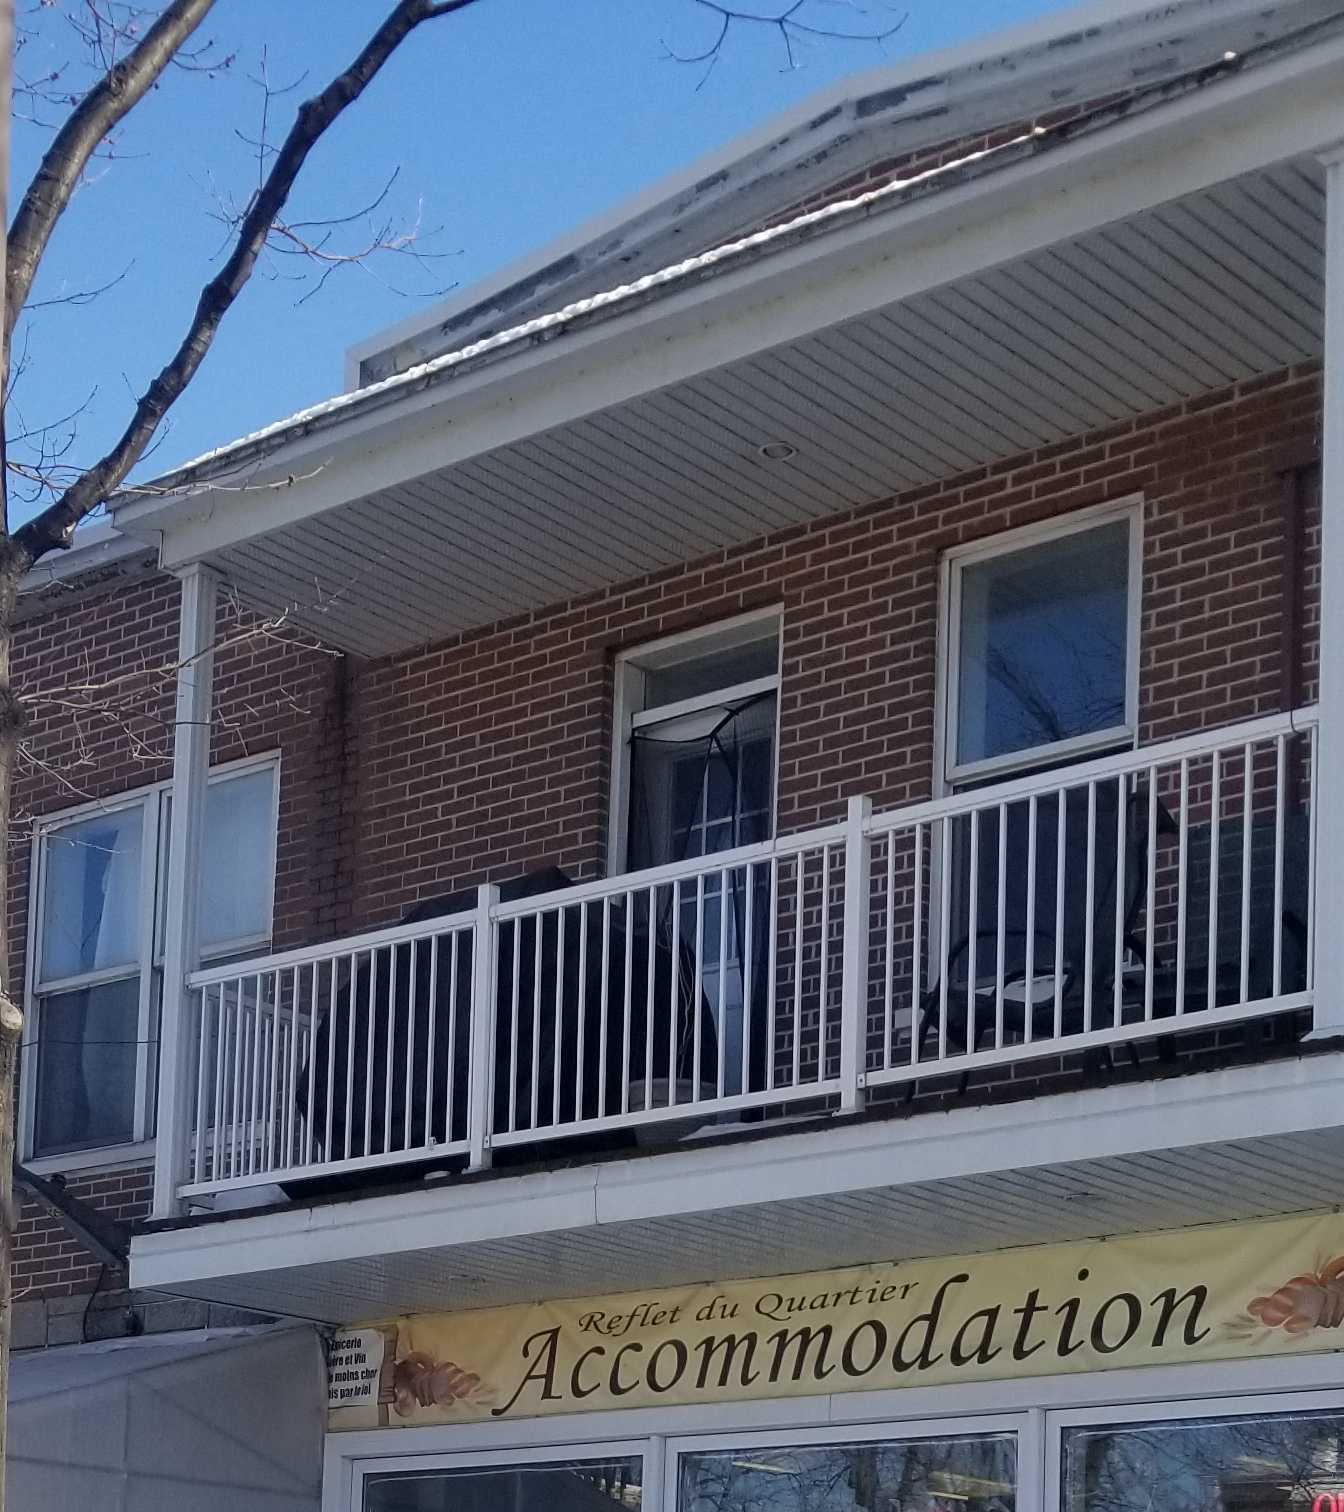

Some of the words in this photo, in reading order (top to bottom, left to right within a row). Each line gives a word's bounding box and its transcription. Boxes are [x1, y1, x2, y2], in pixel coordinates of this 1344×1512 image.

[578, 1301, 681, 1337] Reflet
[695, 1294, 738, 1321] du
[754, 1279, 920, 1321] Quartier
[491, 1268, 1211, 1416] Accommodation
[335, 1369, 360, 1382] moins
